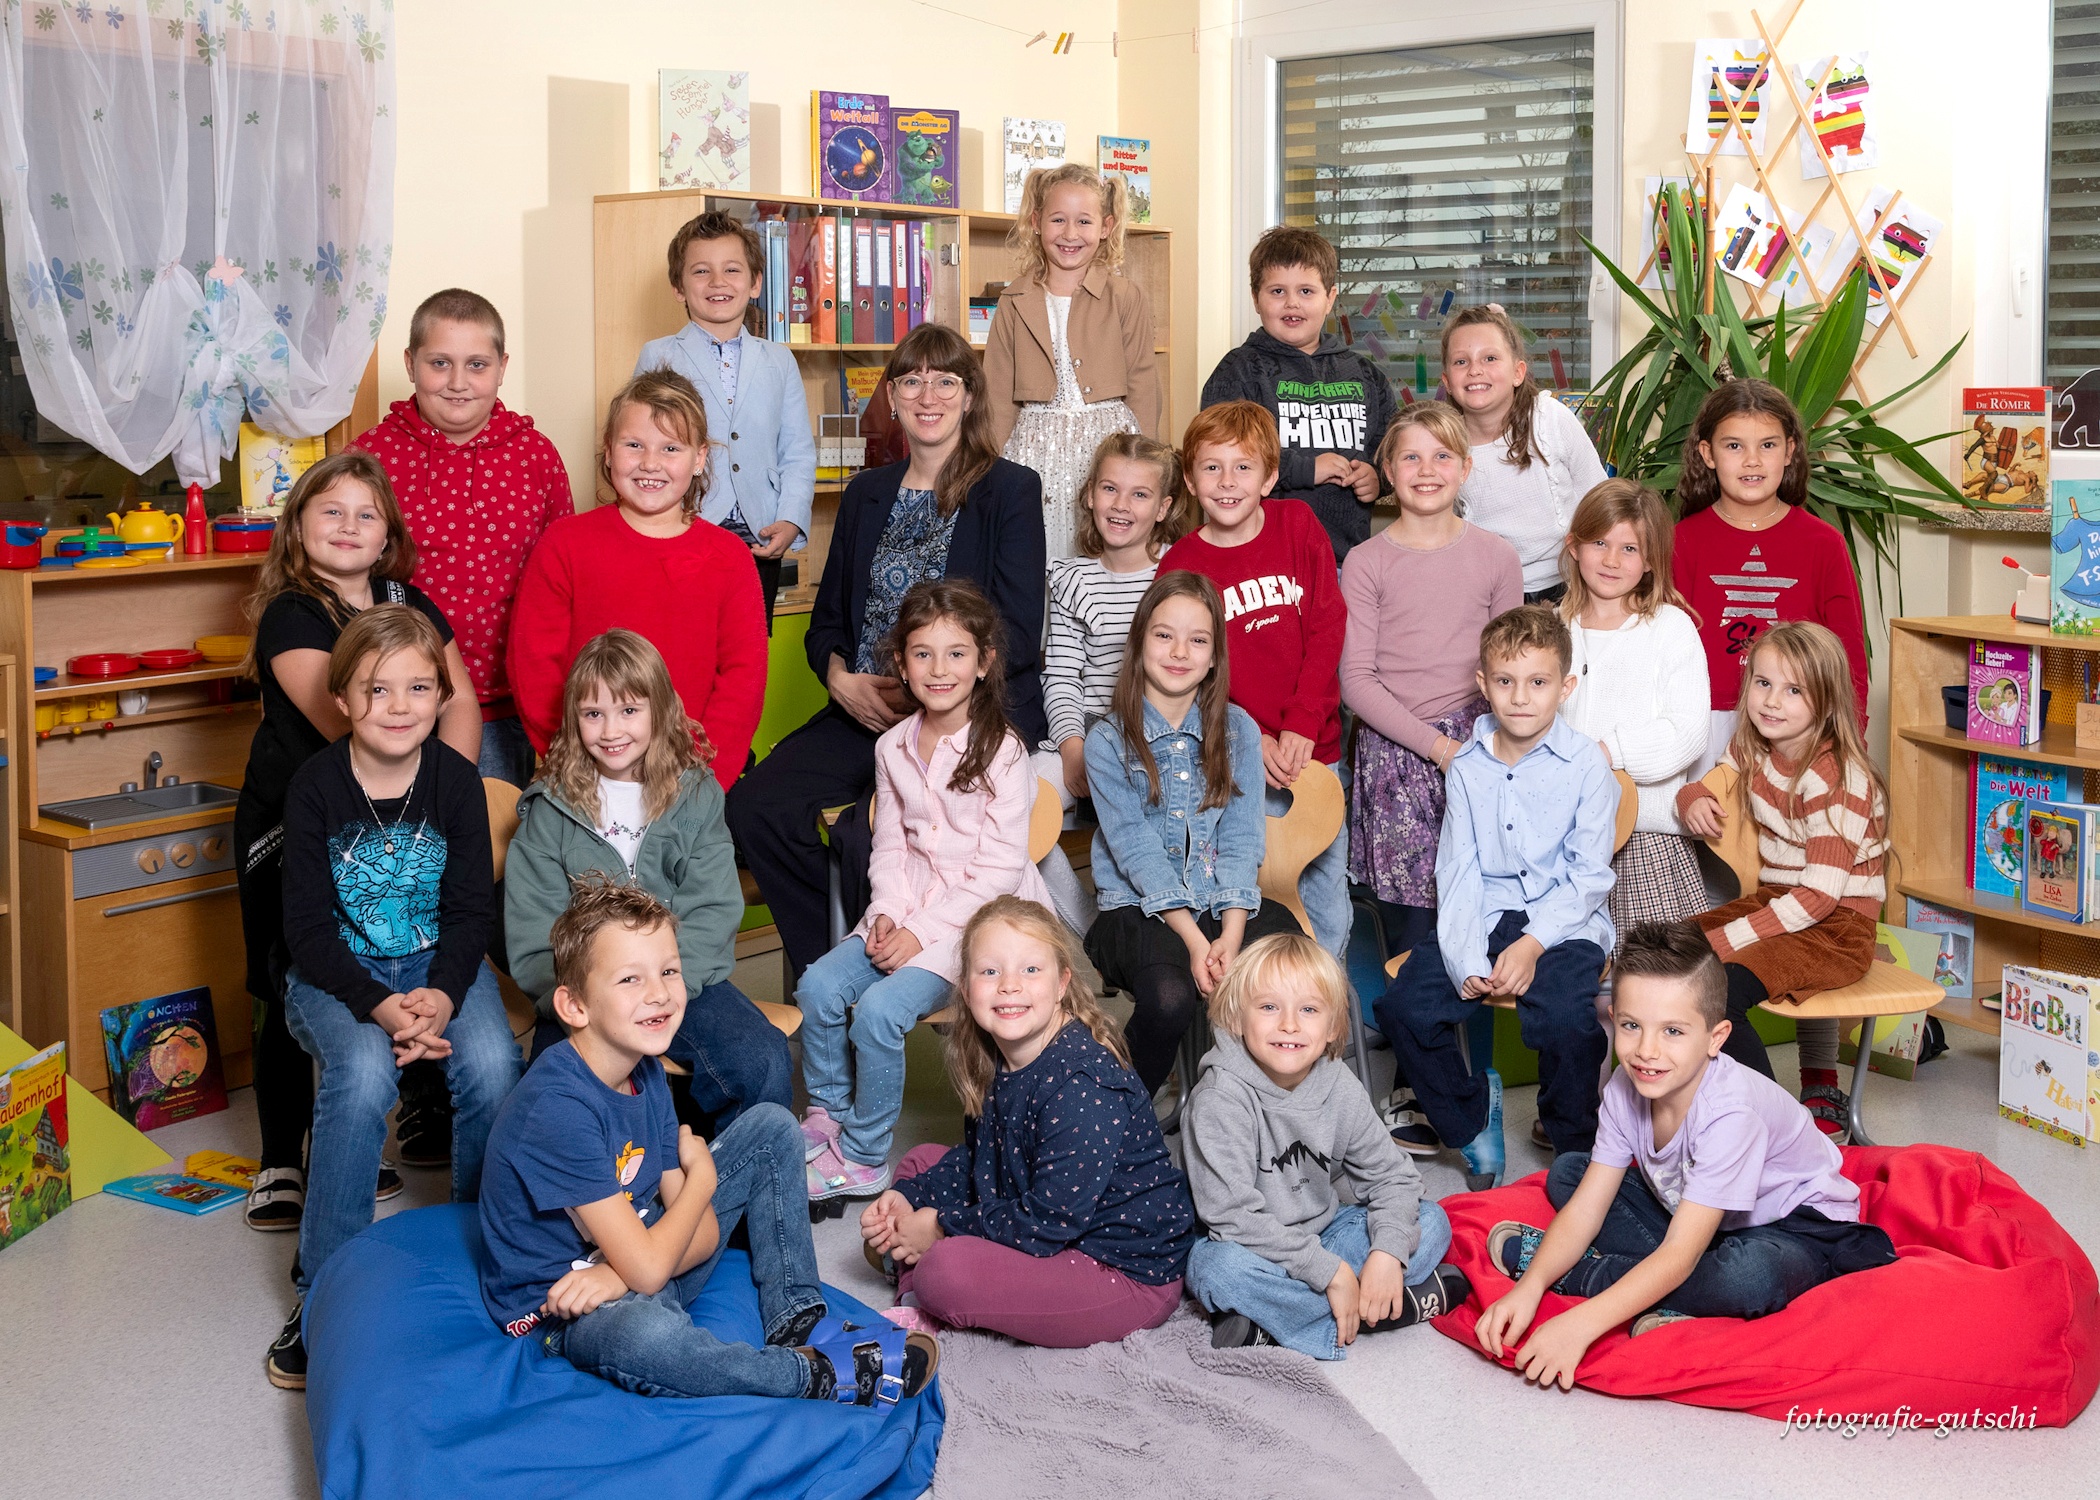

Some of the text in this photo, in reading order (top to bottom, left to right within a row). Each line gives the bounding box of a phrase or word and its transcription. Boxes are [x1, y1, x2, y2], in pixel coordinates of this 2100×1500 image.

[676, 92, 708, 119] Hunger
[837, 96, 864, 110] Erde
[830, 109, 879, 124] Weltall
[1113, 150, 1137, 160] Ritter
[1103, 162, 1148, 174] und Burgen
[1276, 380, 1365, 402] MINECRAFT
[1277, 402, 1367, 420] ADVENTURE
[1990, 397, 2031, 410] RÖMER
[1279, 416, 1367, 452] MODE
[1255, 614, 1280, 631] sports
[1985, 761, 2060, 784] KINDERATLAS
[1990, 780, 2051, 800] Die Welt
[2044, 884, 2062, 896] LISA
[2004, 980, 2083, 1044] BieBu
